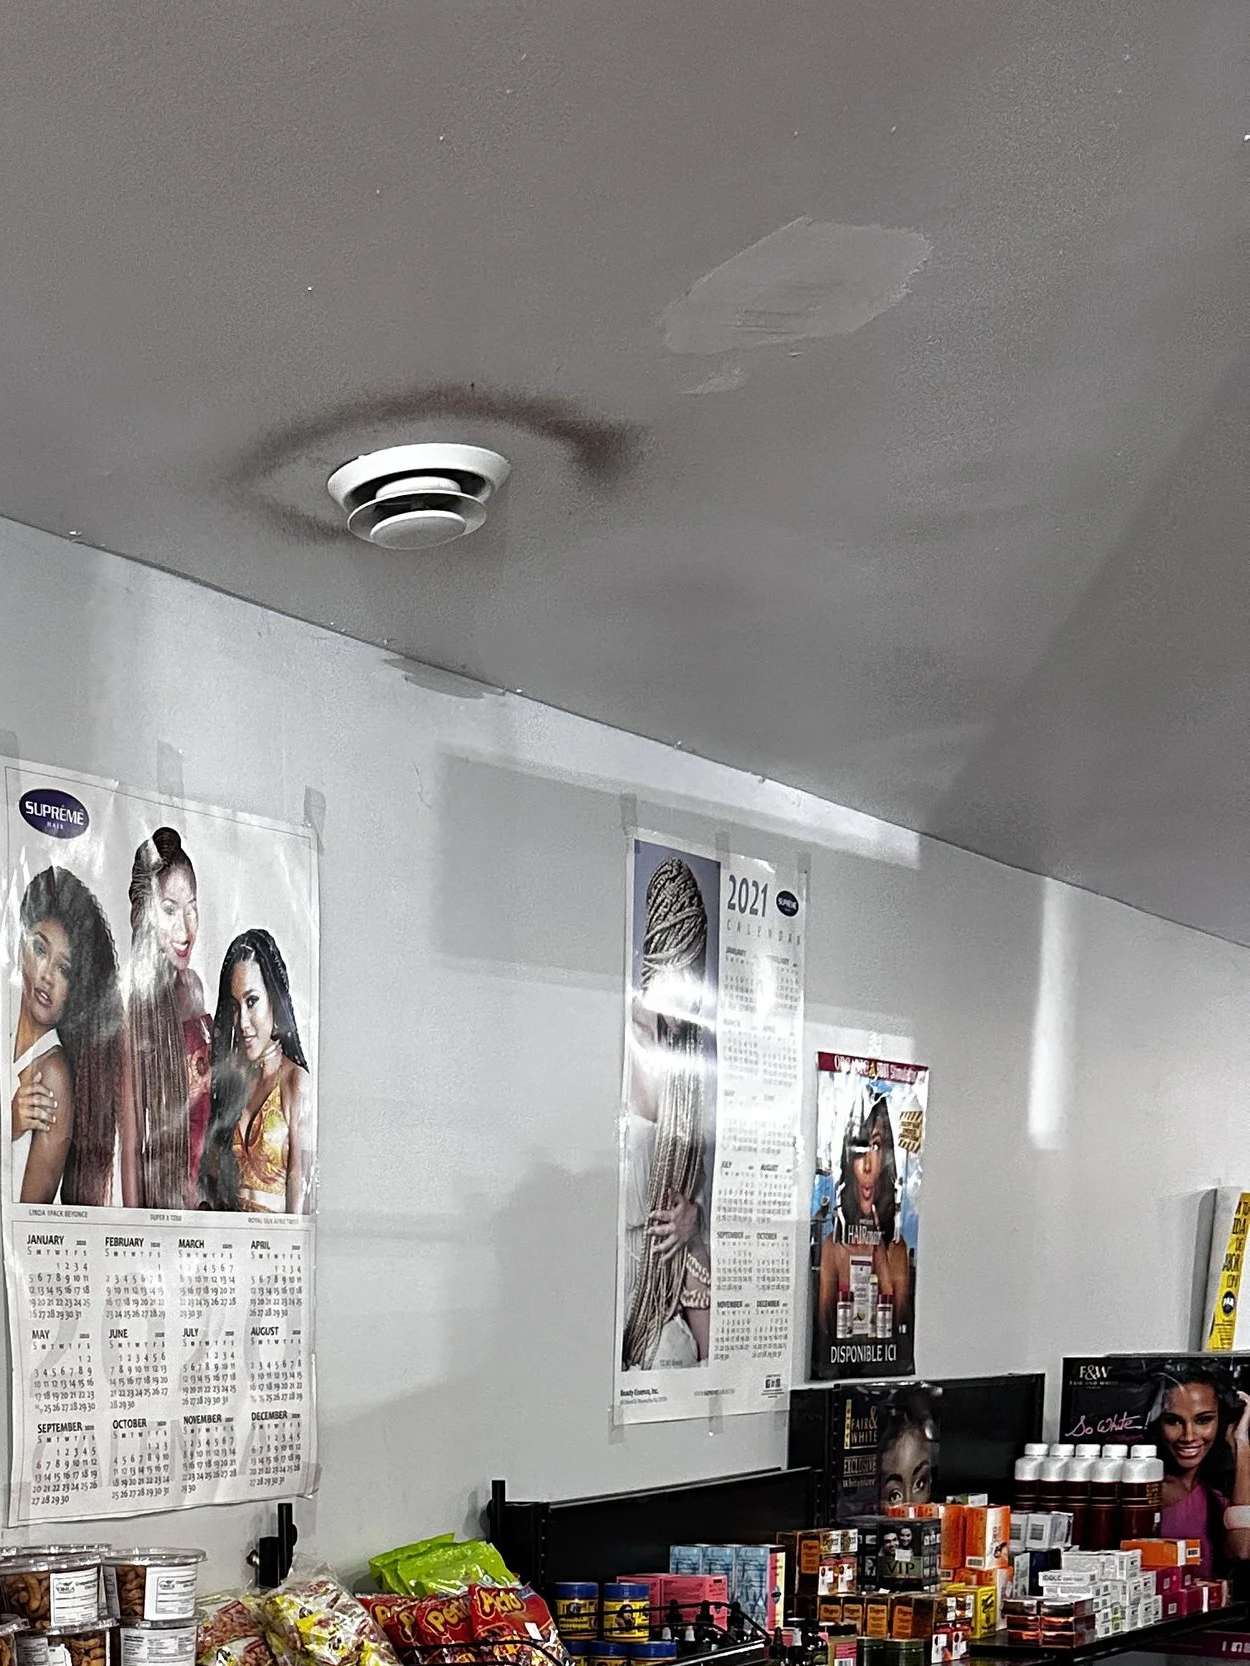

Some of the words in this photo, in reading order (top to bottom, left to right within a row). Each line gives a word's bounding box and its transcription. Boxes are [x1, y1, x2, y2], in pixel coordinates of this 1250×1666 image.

[727, 874, 768, 918] 2021
[27, 1234, 64, 1246] JANUARY
[105, 1237, 144, 1247] FEBRUARY
[178, 1239, 205, 1249] MARCH
[250, 1240, 270, 1250] APRIL
[32, 1329, 50, 1339] MAY
[108, 1329, 128, 1339] JUNE
[183, 1328, 198, 1337] JULY
[251, 1326, 279, 1335] AUGUST
[831, 1345, 882, 1363] DISPONIBLE
[885, 1344, 896, 1361] ICI
[1079, 1365, 1112, 1380] F&W
[37, 1422, 82, 1434] SEPTEMBER
[112, 1418, 147, 1429] OCTOBER
[183, 1414, 222, 1424] NOVEMBER
[251, 1410, 288, 1420] DECEMBER
[851, 1430, 877, 1444] WHITE
[886, 1561, 915, 1575] VIP
